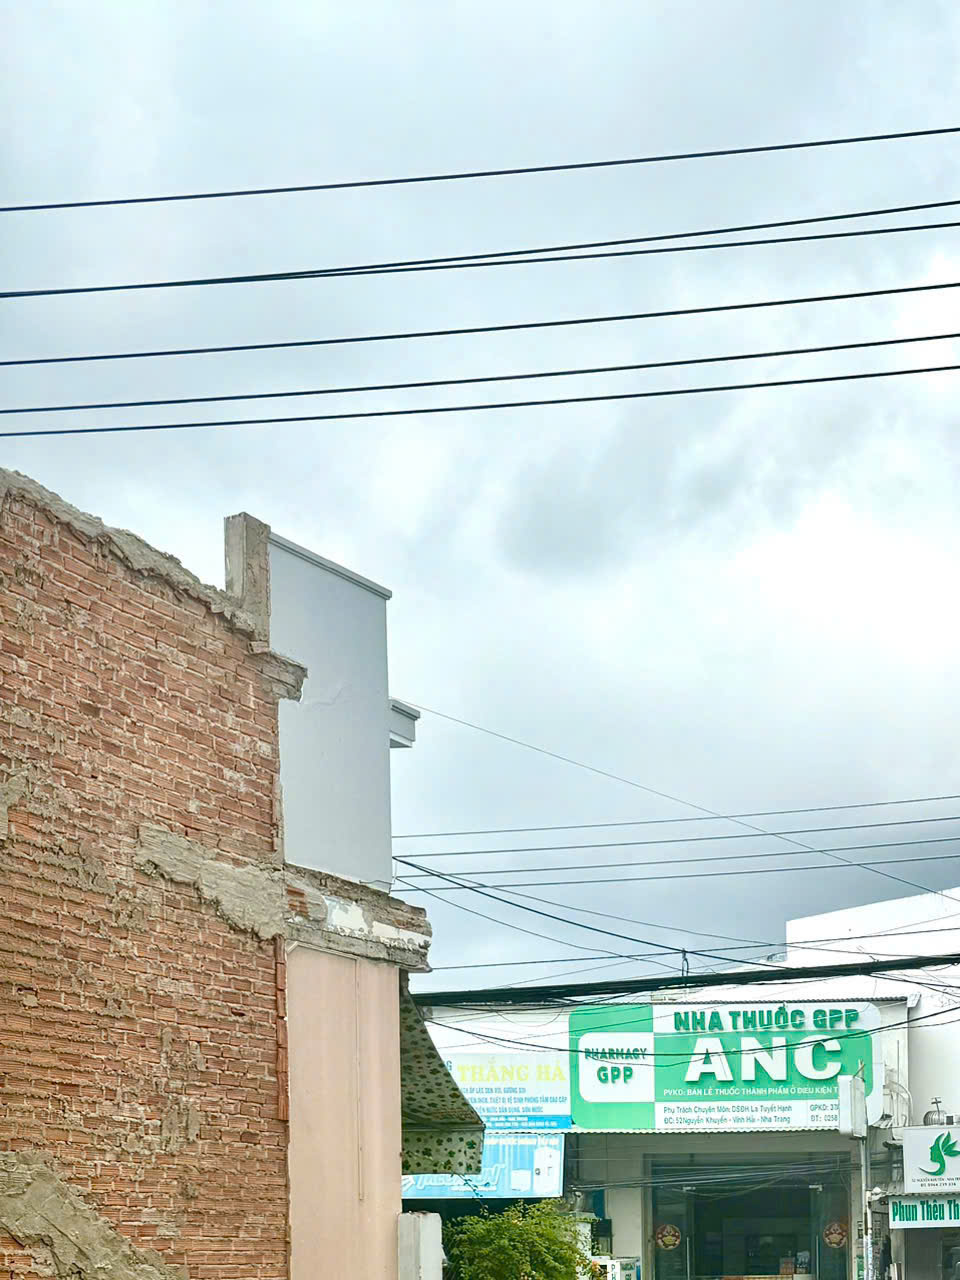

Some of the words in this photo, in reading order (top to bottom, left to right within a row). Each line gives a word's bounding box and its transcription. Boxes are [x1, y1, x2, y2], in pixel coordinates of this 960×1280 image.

[728, 1004, 805, 1030] THUỐC
[812, 1008, 860, 1029] GPP
[584, 1047, 647, 1060] PHARMACY
[684, 1034, 843, 1083] ANC
[596, 1066, 634, 1084] GPP
[892, 1200, 918, 1222] Phun
[919, 1198, 945, 1221] Thêu
